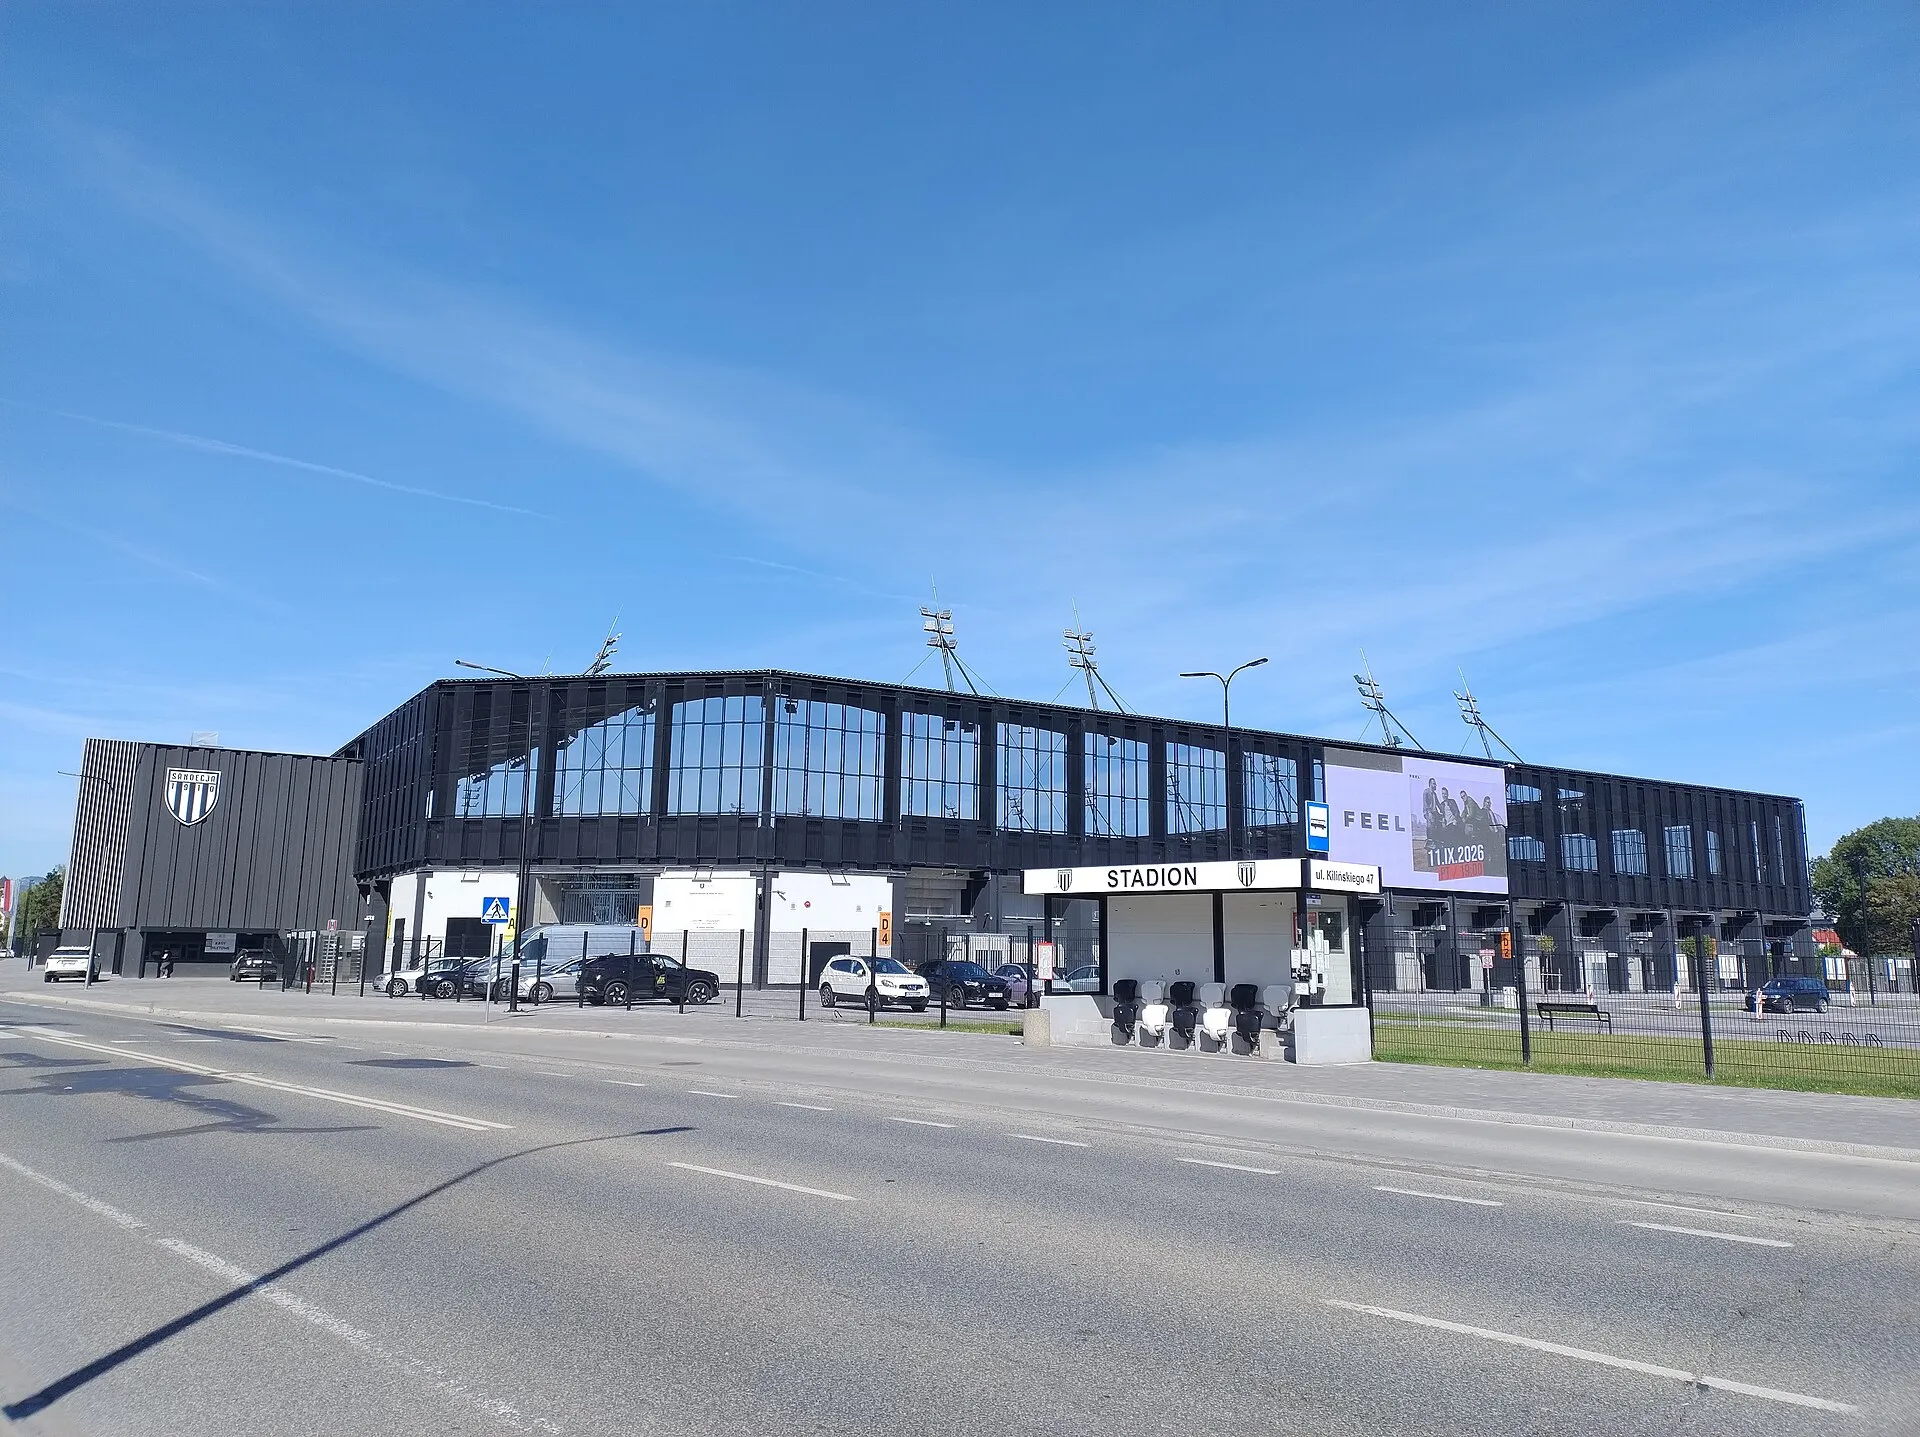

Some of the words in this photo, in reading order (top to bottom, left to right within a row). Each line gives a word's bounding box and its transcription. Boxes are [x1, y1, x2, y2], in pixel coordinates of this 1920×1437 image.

[171, 772, 216, 783] SANDECJA
[1343, 810, 1406, 832] FEEL
[1428, 844, 1485, 867] 11.IX.2026
[1107, 866, 1197, 888] STADION
[1315, 869, 1325, 880] ul.
[1326, 869, 1365, 886] Kilińskiego
[1366, 873, 1375, 885] 47
[507, 917, 516, 930] A
[641, 917, 649, 929] D
[882, 918, 889, 930] D
[881, 932, 889, 945] 4
